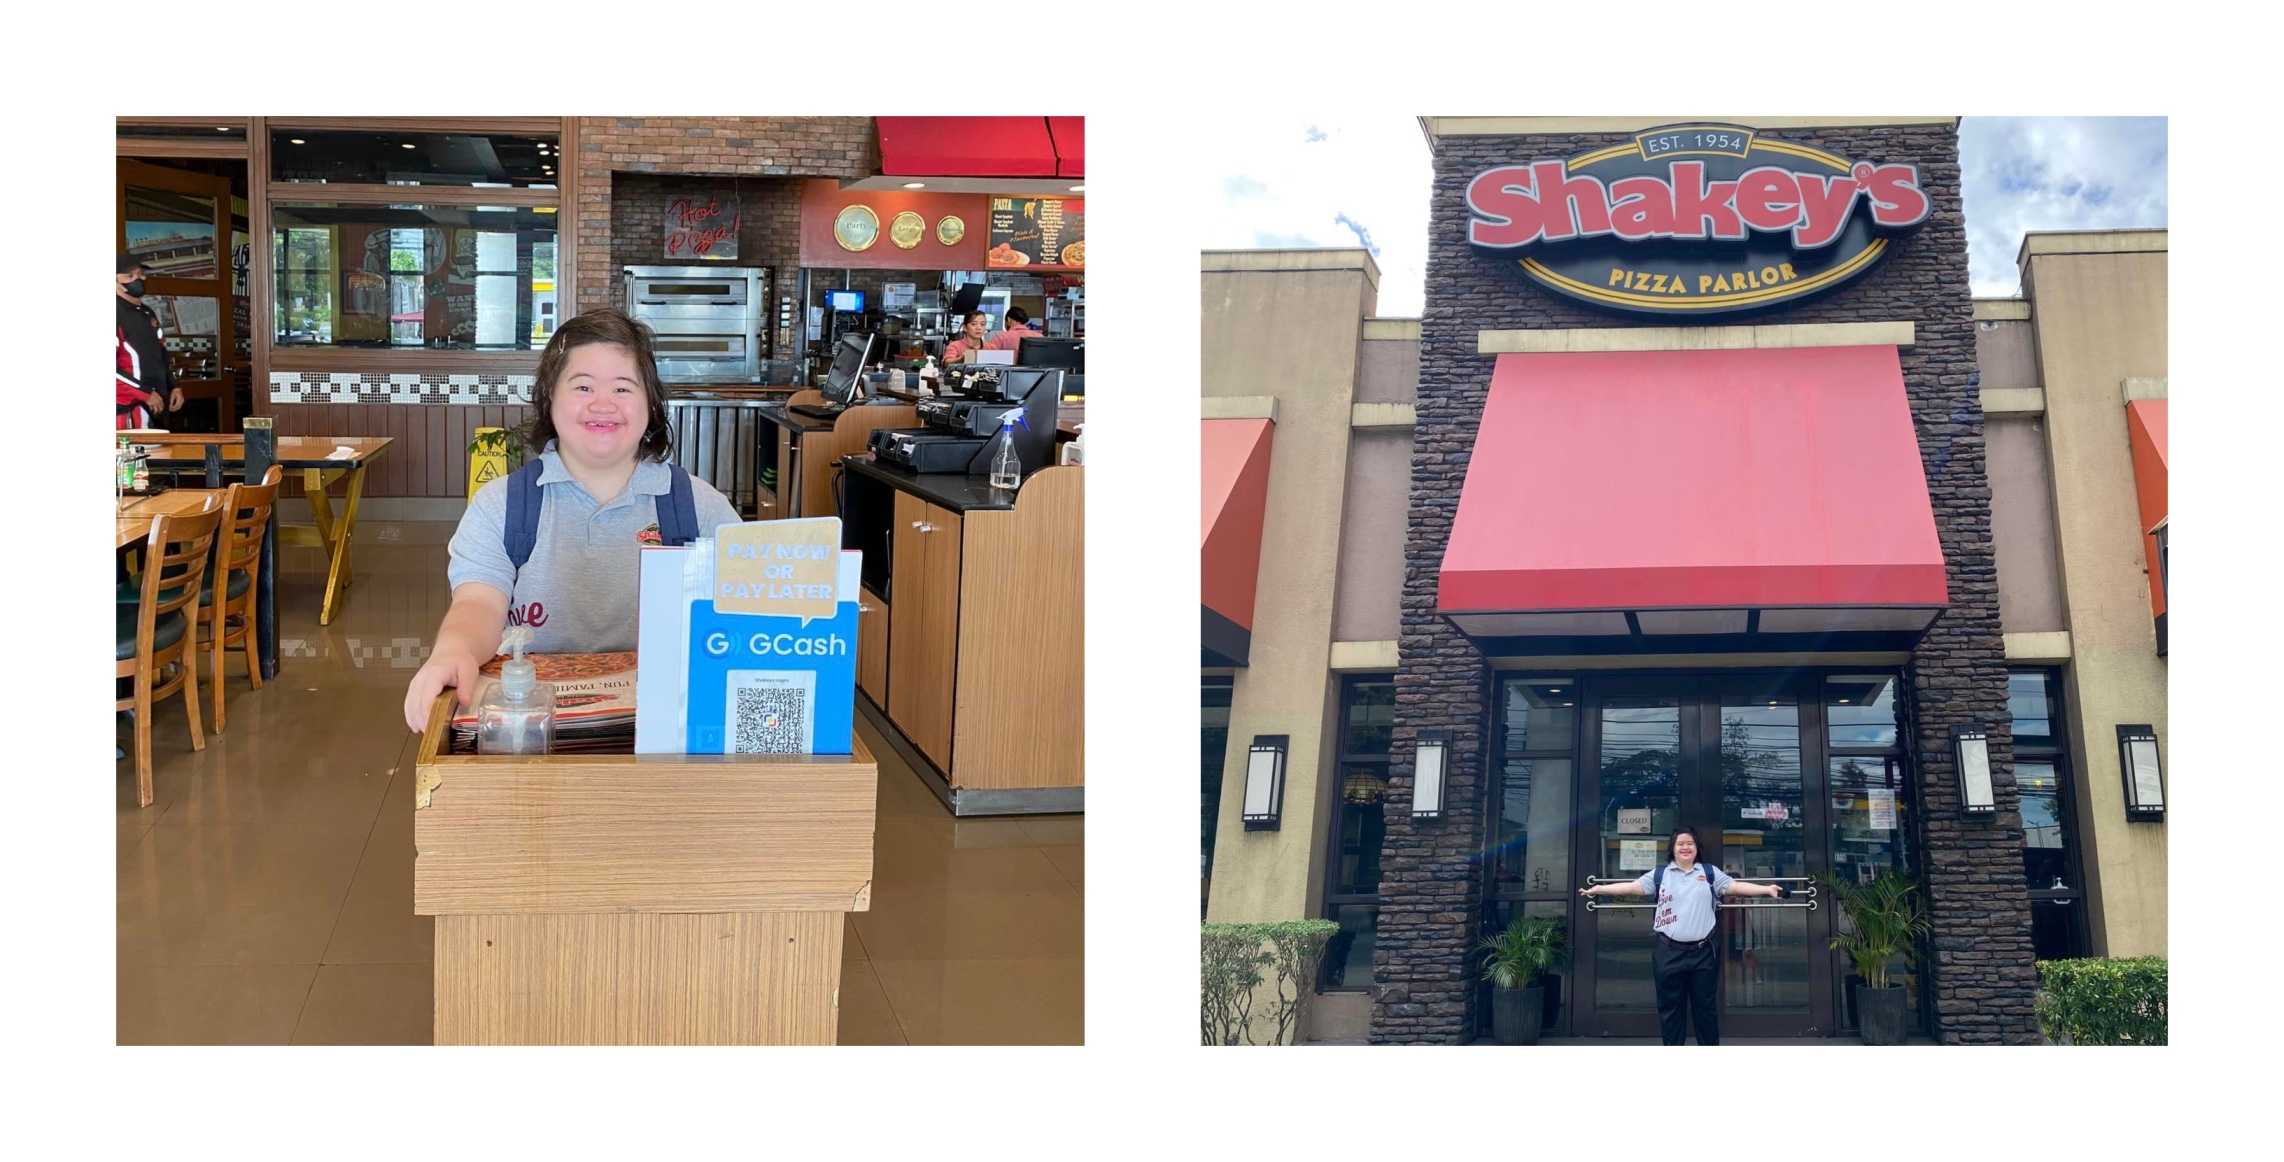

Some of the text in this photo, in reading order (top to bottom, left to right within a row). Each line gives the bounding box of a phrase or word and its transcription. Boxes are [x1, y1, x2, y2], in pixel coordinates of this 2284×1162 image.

[1648, 134, 1741, 154] EST. 1954
[668, 192, 720, 229] Hot
[1466, 160, 1931, 249] Shakey's
[1608, 262, 1798, 294] PIZZA PARLOR
[727, 543, 833, 560] PAY NOW
[763, 563, 794, 579] OR
[719, 583, 833, 599] PAY LATER
[749, 632, 846, 656] GCash
